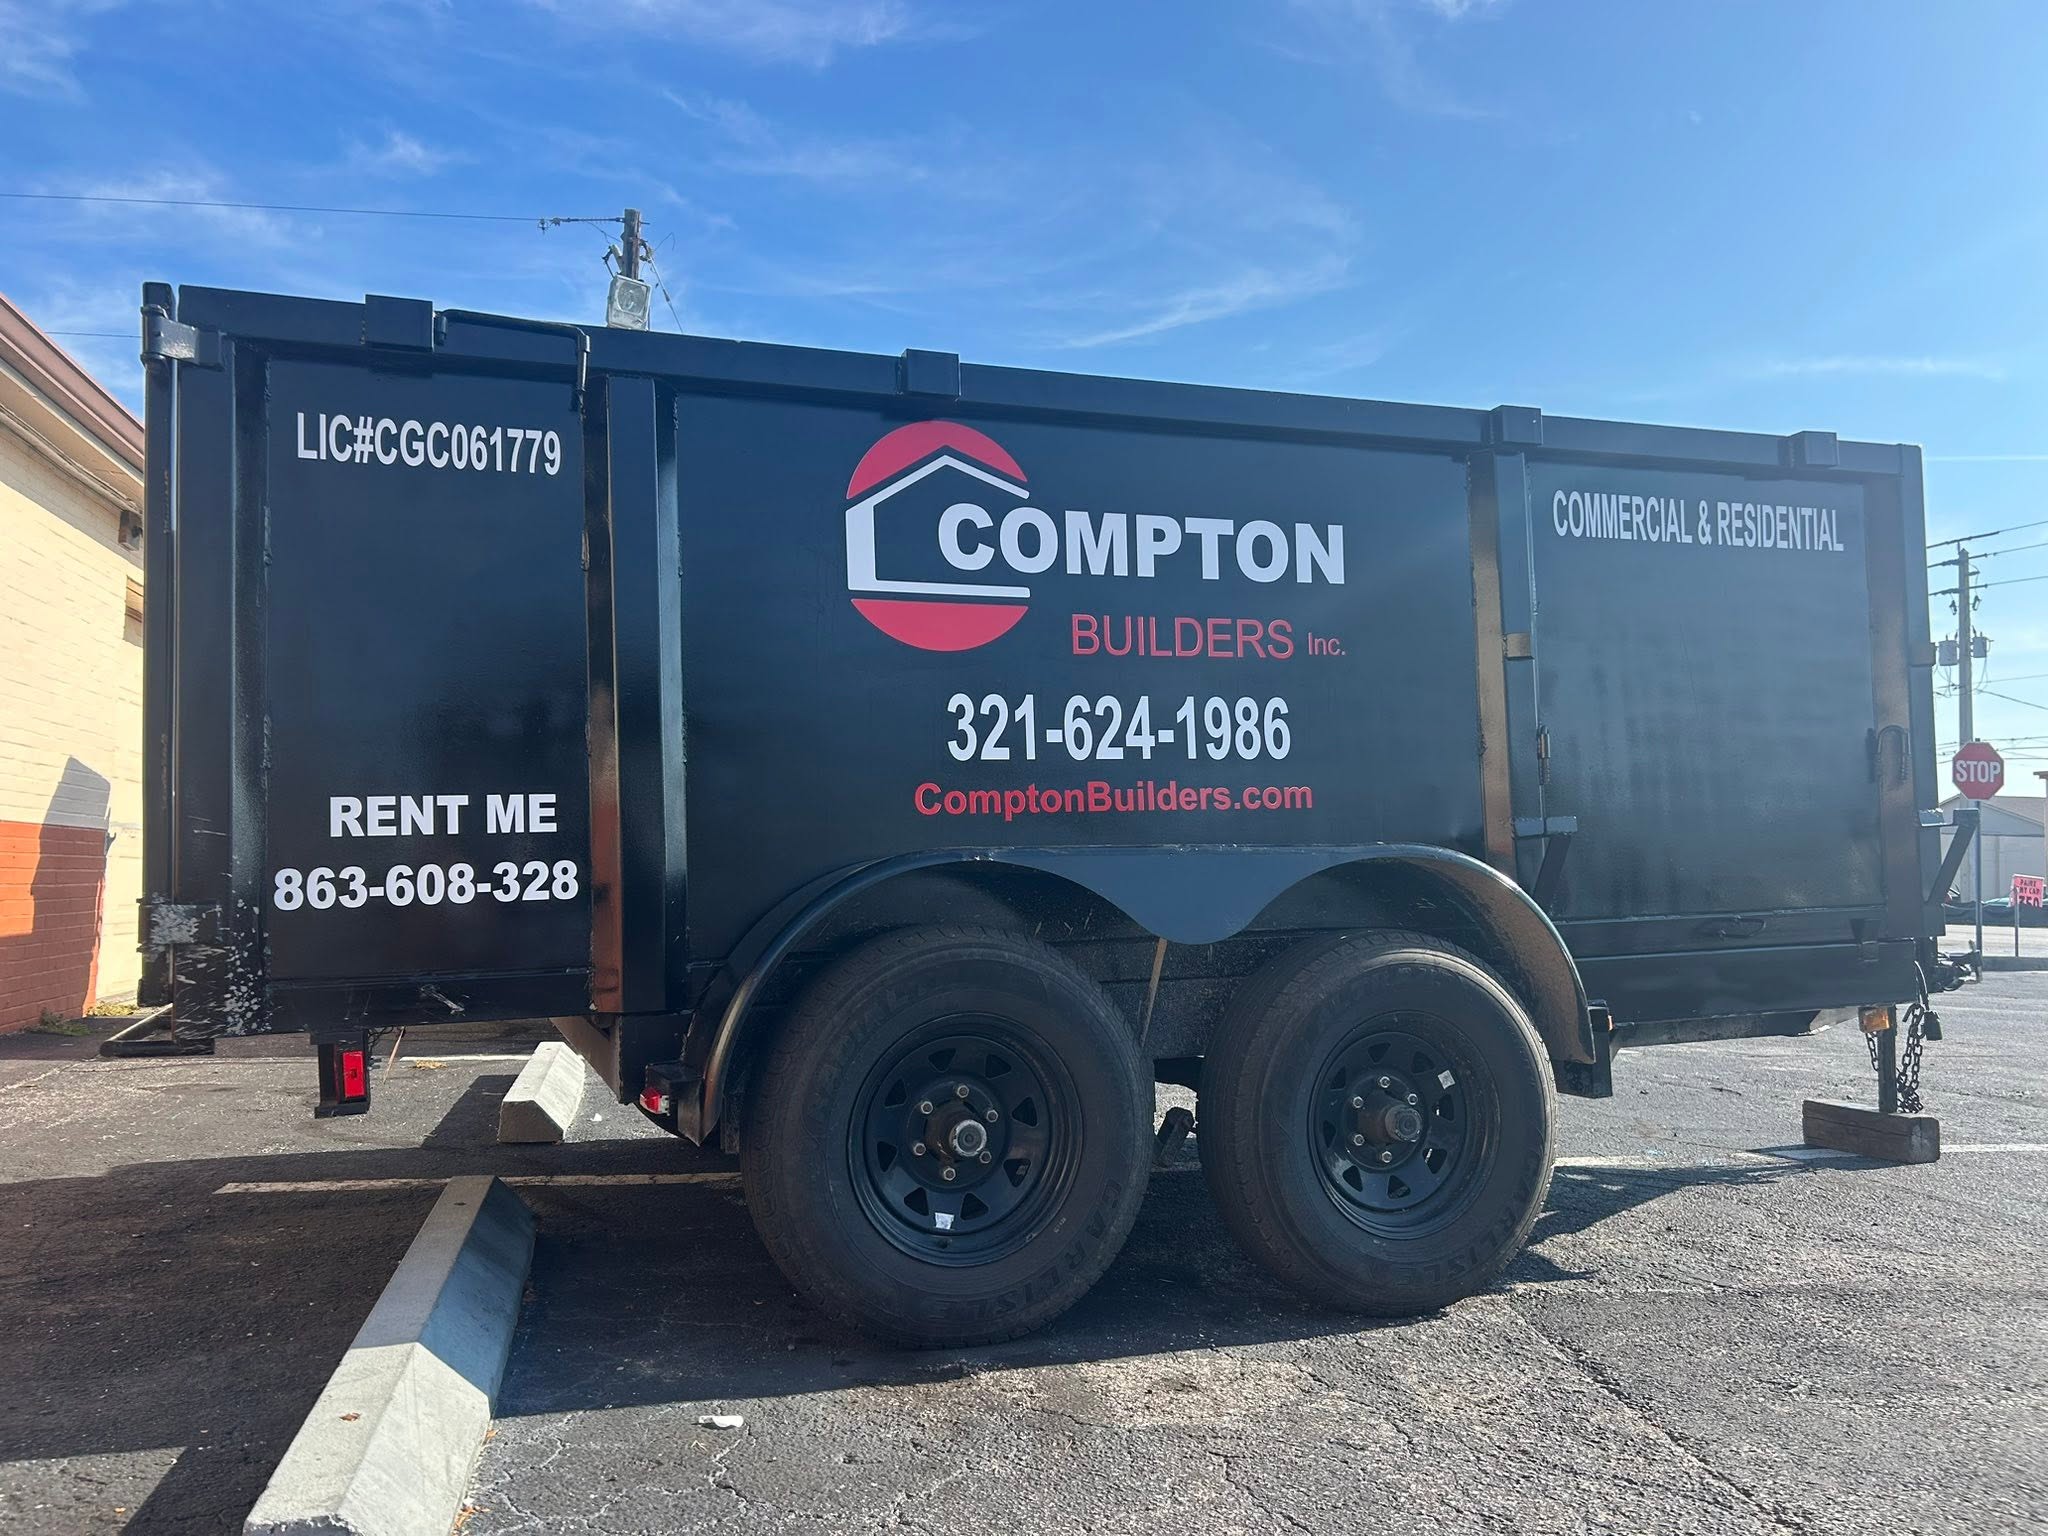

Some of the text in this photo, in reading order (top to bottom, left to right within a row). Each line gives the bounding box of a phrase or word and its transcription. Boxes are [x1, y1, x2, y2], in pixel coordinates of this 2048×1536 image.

[297, 412, 562, 475] LIC#CGC061779
[938, 503, 1346, 585] COMPTON
[1553, 490, 1845, 552] COMMERCIAL & RESIDENTIAL
[1071, 614, 1347, 660] BUILDERS Inc.
[947, 693, 1292, 762] 321-624-1986
[1956, 760, 2000, 783] STOP
[329, 794, 558, 838] RENT ME
[914, 780, 1314, 821] ComptonBuilders.com
[273, 860, 580, 912] 863-608-328
